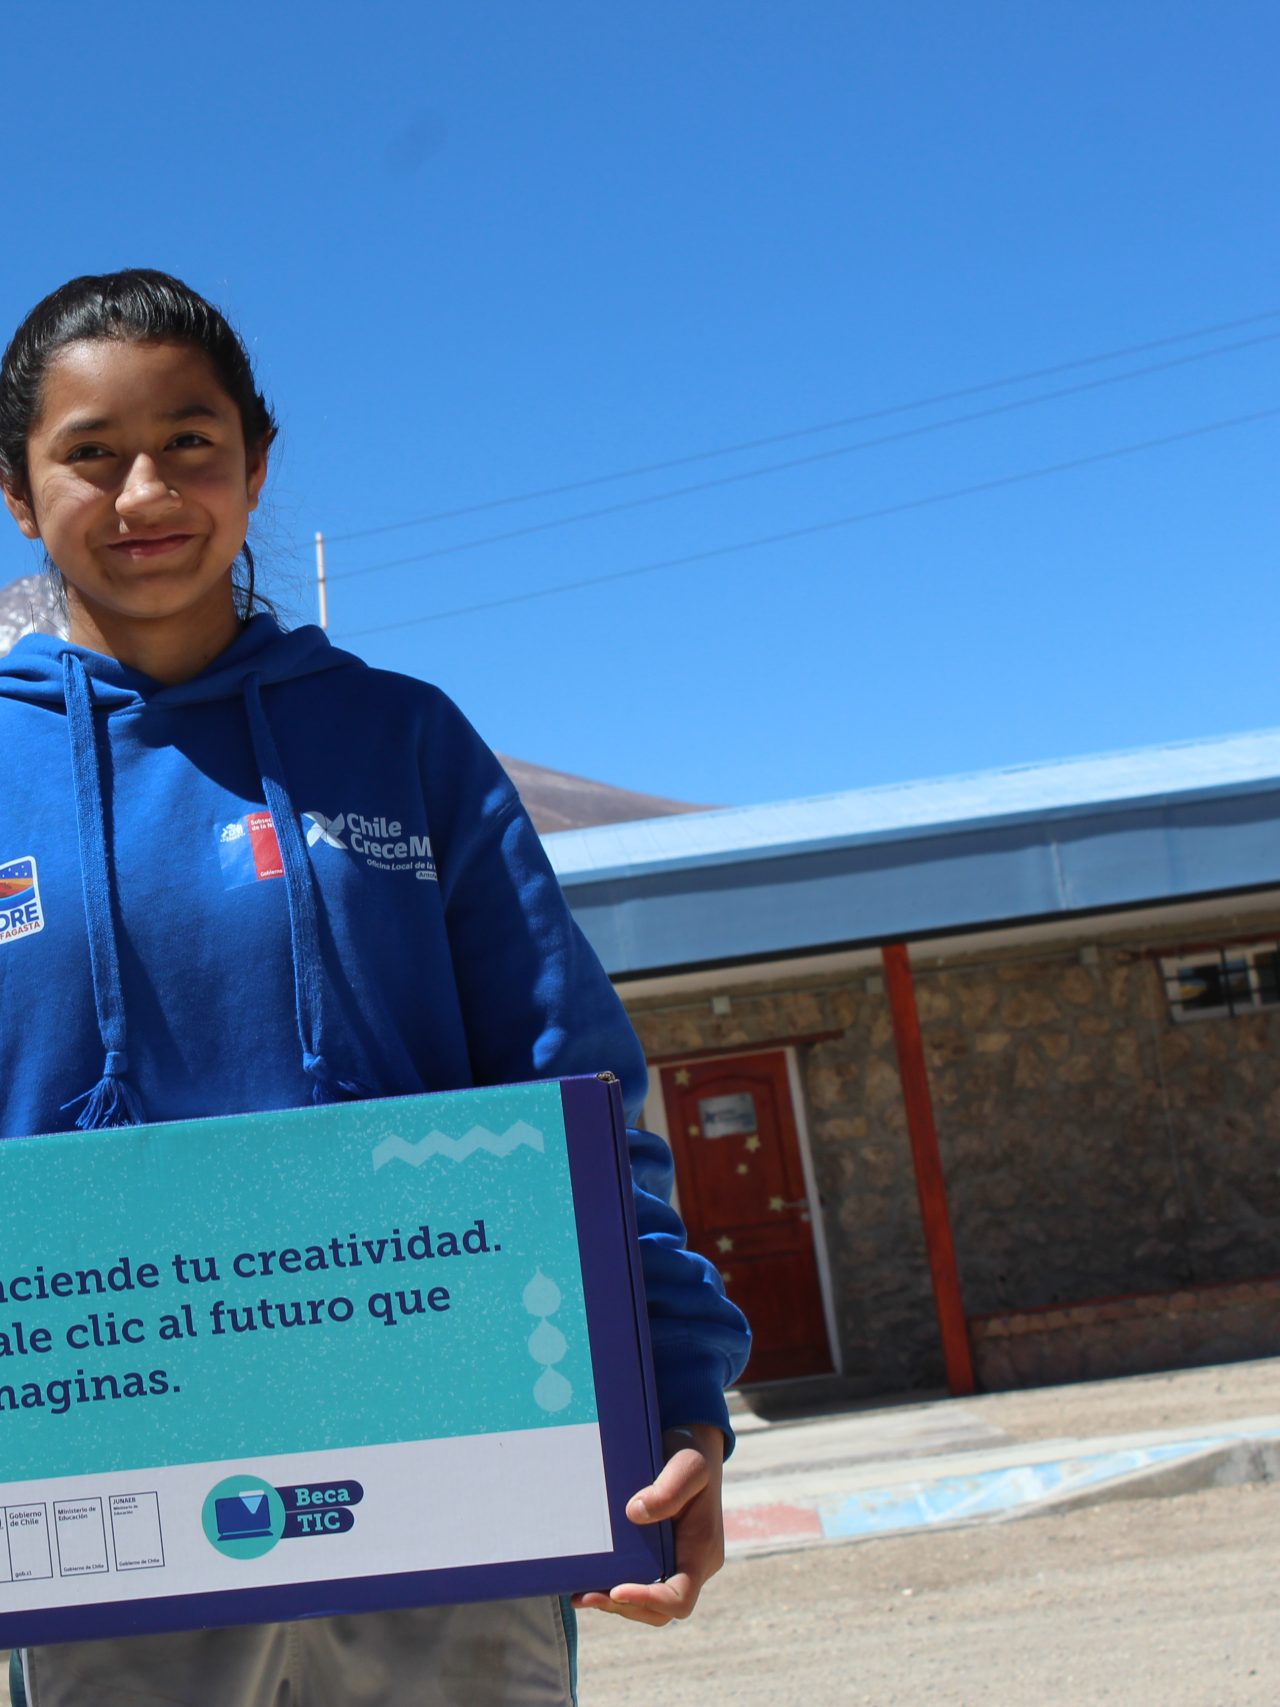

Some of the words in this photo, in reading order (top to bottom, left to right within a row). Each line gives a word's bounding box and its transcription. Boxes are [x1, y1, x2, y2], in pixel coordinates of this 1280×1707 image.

[346, 812, 402, 838] Chile
[366, 858, 391, 871] Oficina
[391, 861, 413, 871] Local
[414, 860, 425, 869] de
[426, 861, 433, 870] la
[260, 868, 283, 877] Gobierno
[171, 1254, 220, 1284] tu
[232, 1219, 502, 1278] creatividad.
[65, 1312, 146, 1350] clic
[158, 1303, 198, 1341] al
[209, 1296, 354, 1335] futuro
[367, 1286, 451, 1327] que
[113, 1496, 137, 1505] JUNAEB
[294, 1488, 351, 1507] Beca
[9, 1510, 42, 1520] Gobierno
[57, 1506, 88, 1516] Ministerio
[9, 1519, 19, 1527] de
[20, 1518, 40, 1526] Chile
[58, 1513, 89, 1522] Educación
[297, 1511, 341, 1532] TIC
